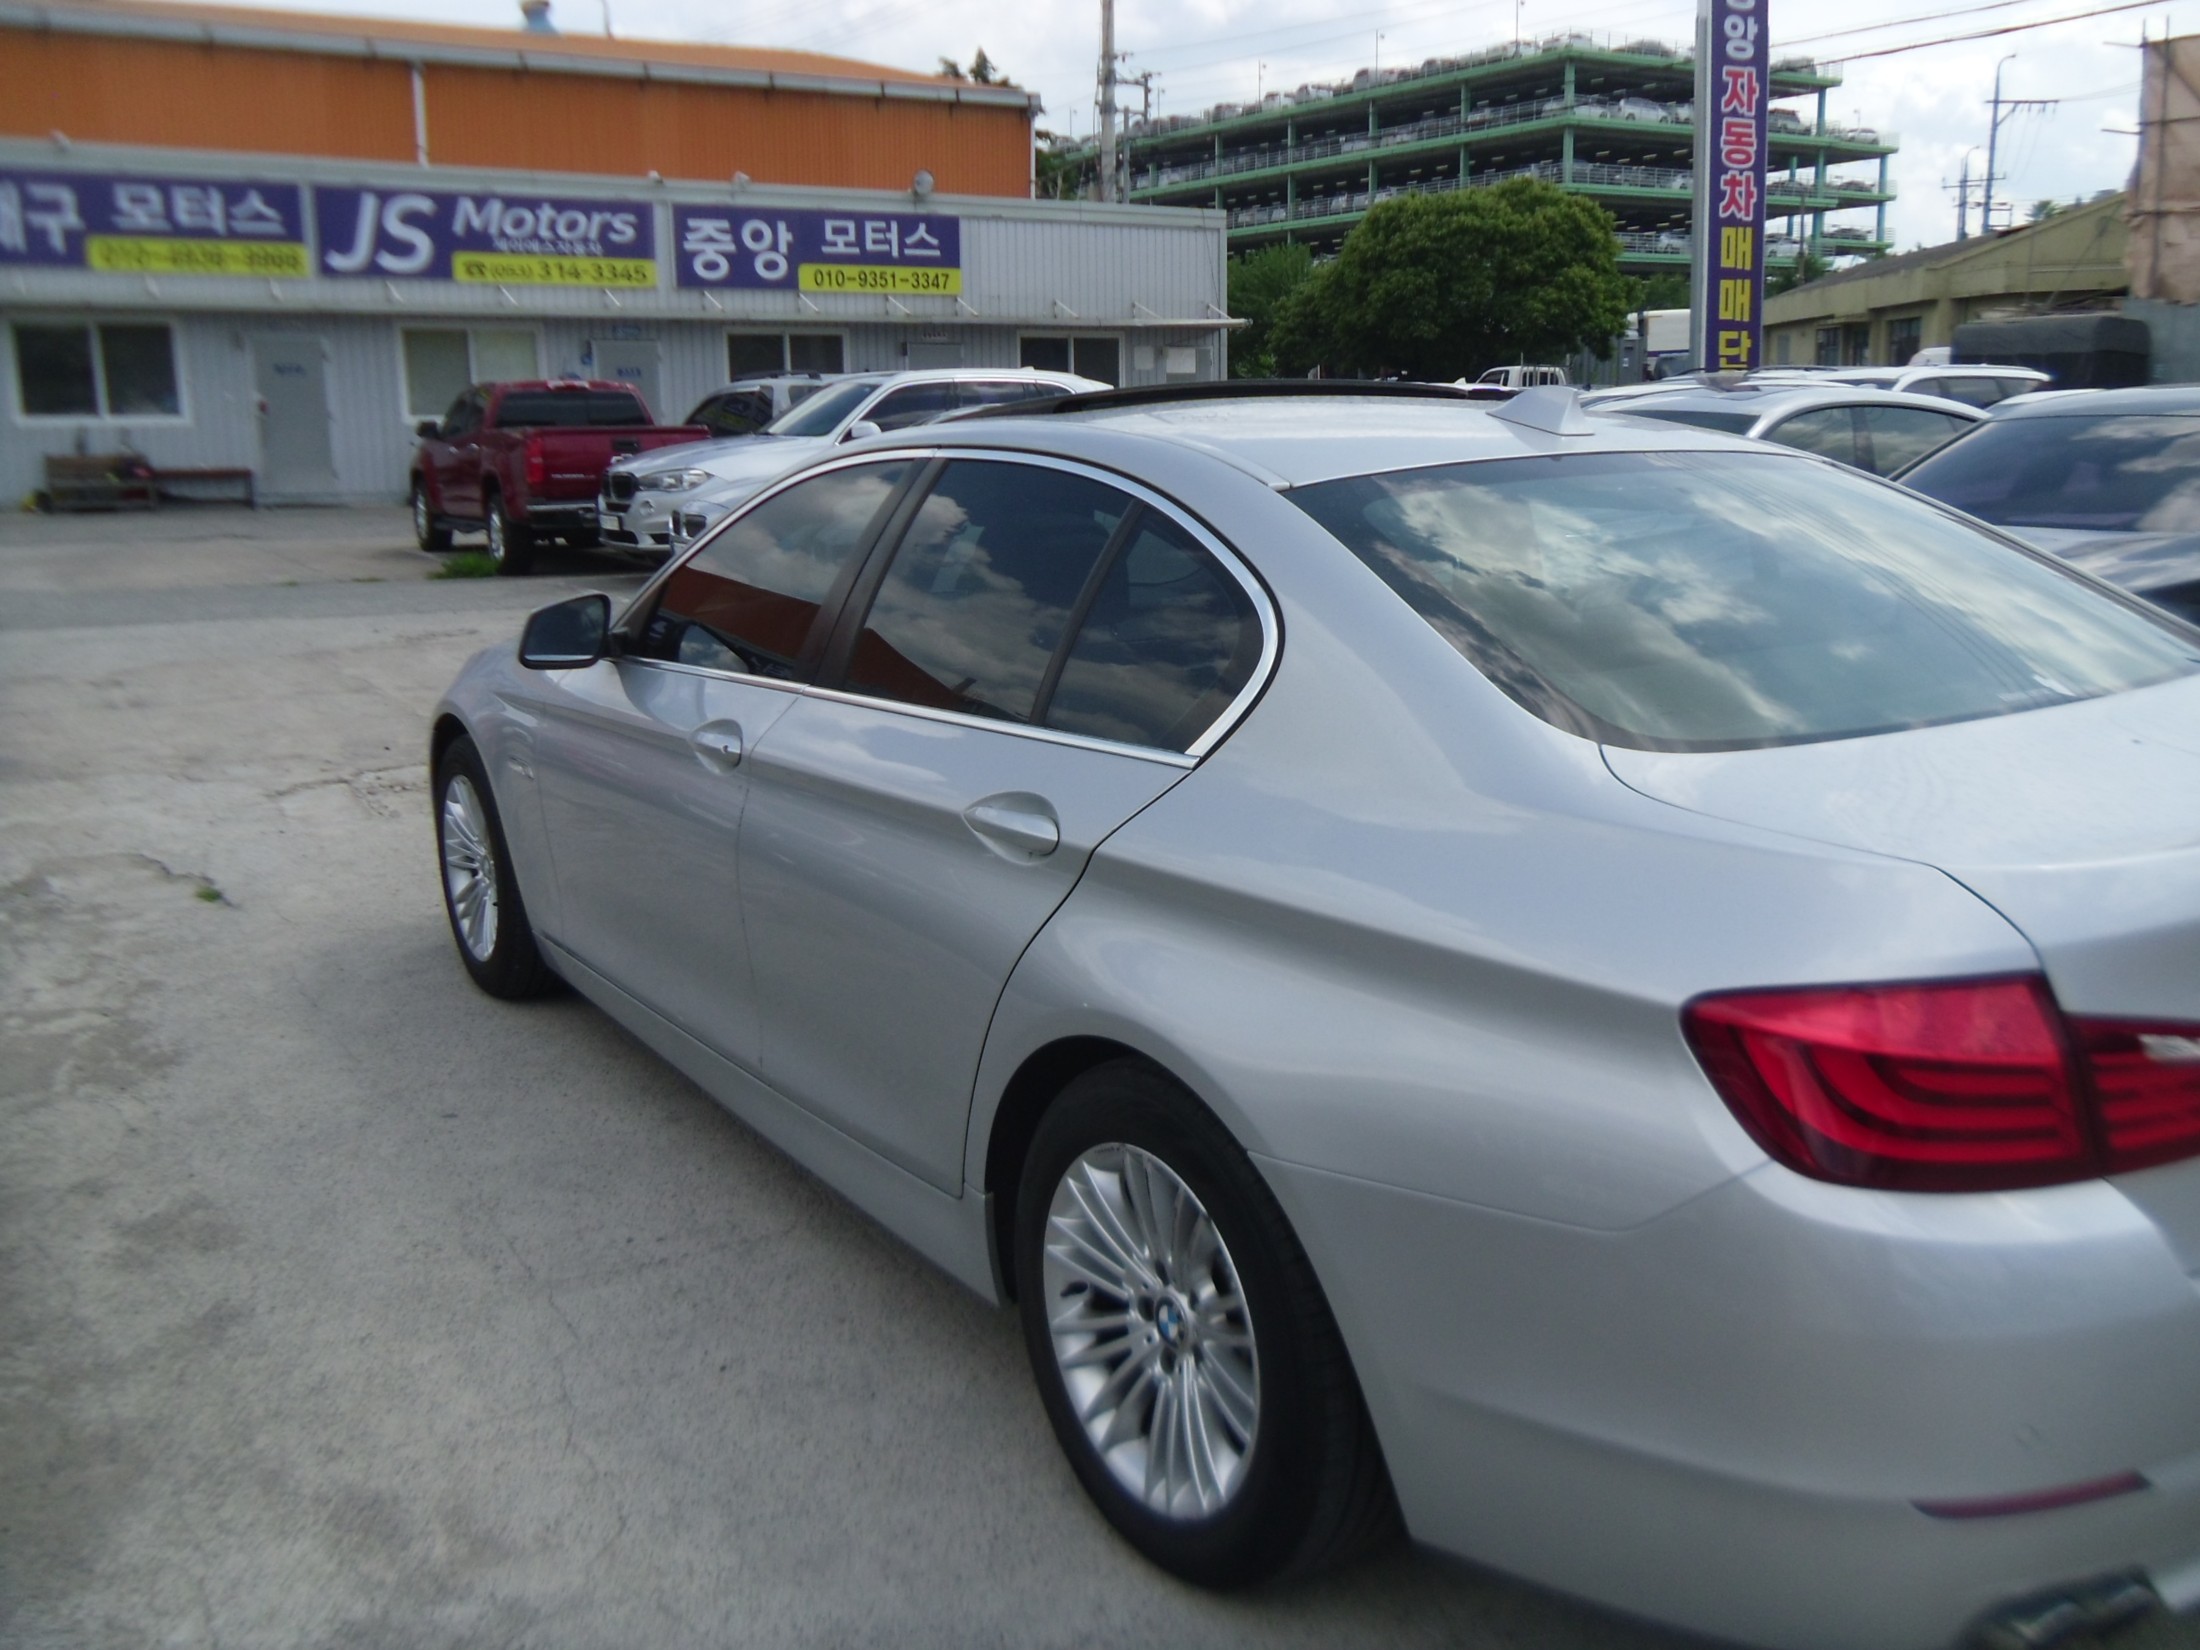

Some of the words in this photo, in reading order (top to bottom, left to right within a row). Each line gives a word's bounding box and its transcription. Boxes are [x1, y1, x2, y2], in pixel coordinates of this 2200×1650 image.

[1719, 65, 1759, 222] 자동차
[110, 183, 287, 237] 모터스
[324, 191, 438, 275] JS
[451, 195, 638, 244] Motors
[537, 261, 648, 282] 314-3345
[683, 218, 794, 281] 중앙
[820, 219, 942, 259] 모터스
[814, 269, 950, 290] 010-9351-3347
